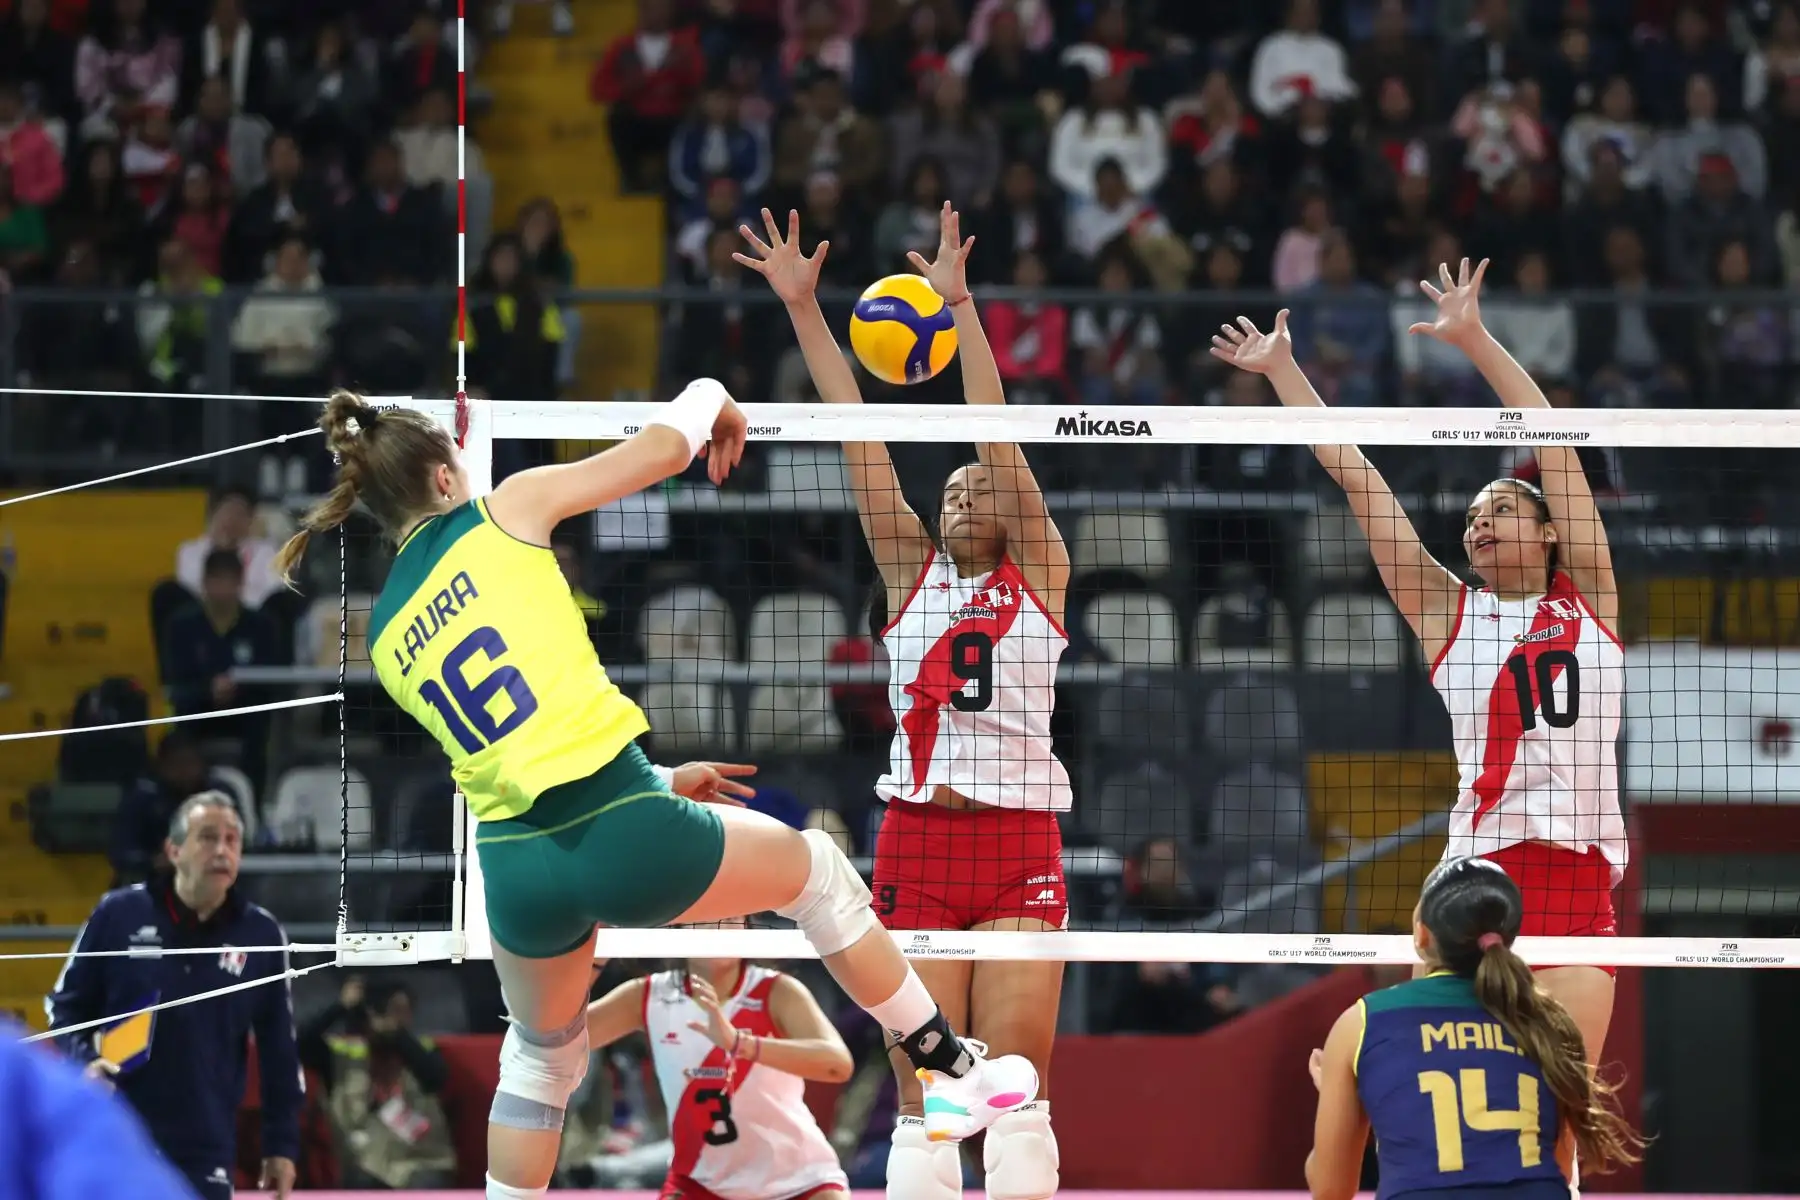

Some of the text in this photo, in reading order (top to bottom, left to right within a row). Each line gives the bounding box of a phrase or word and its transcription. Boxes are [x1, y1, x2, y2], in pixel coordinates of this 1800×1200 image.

[623, 426, 642, 435] GIR
[1055, 410, 1152, 436] MIKASA
[1463, 431, 1480, 439] U17
[1484, 431, 1517, 440] WORLD
[1519, 431, 1590, 440] CHAMPIONSHIP
[1499, 412, 1522, 420] FIVB
[394, 570, 479, 677] LAURA
[1523, 624, 1563, 642] SPORADE
[418, 626, 539, 756] 16
[950, 631, 993, 712] 9
[1506, 650, 1580, 731] 10
[879, 885, 898, 915] 9
[695, 1088, 738, 1146] 3
[1417, 1068, 1541, 1173] 14
